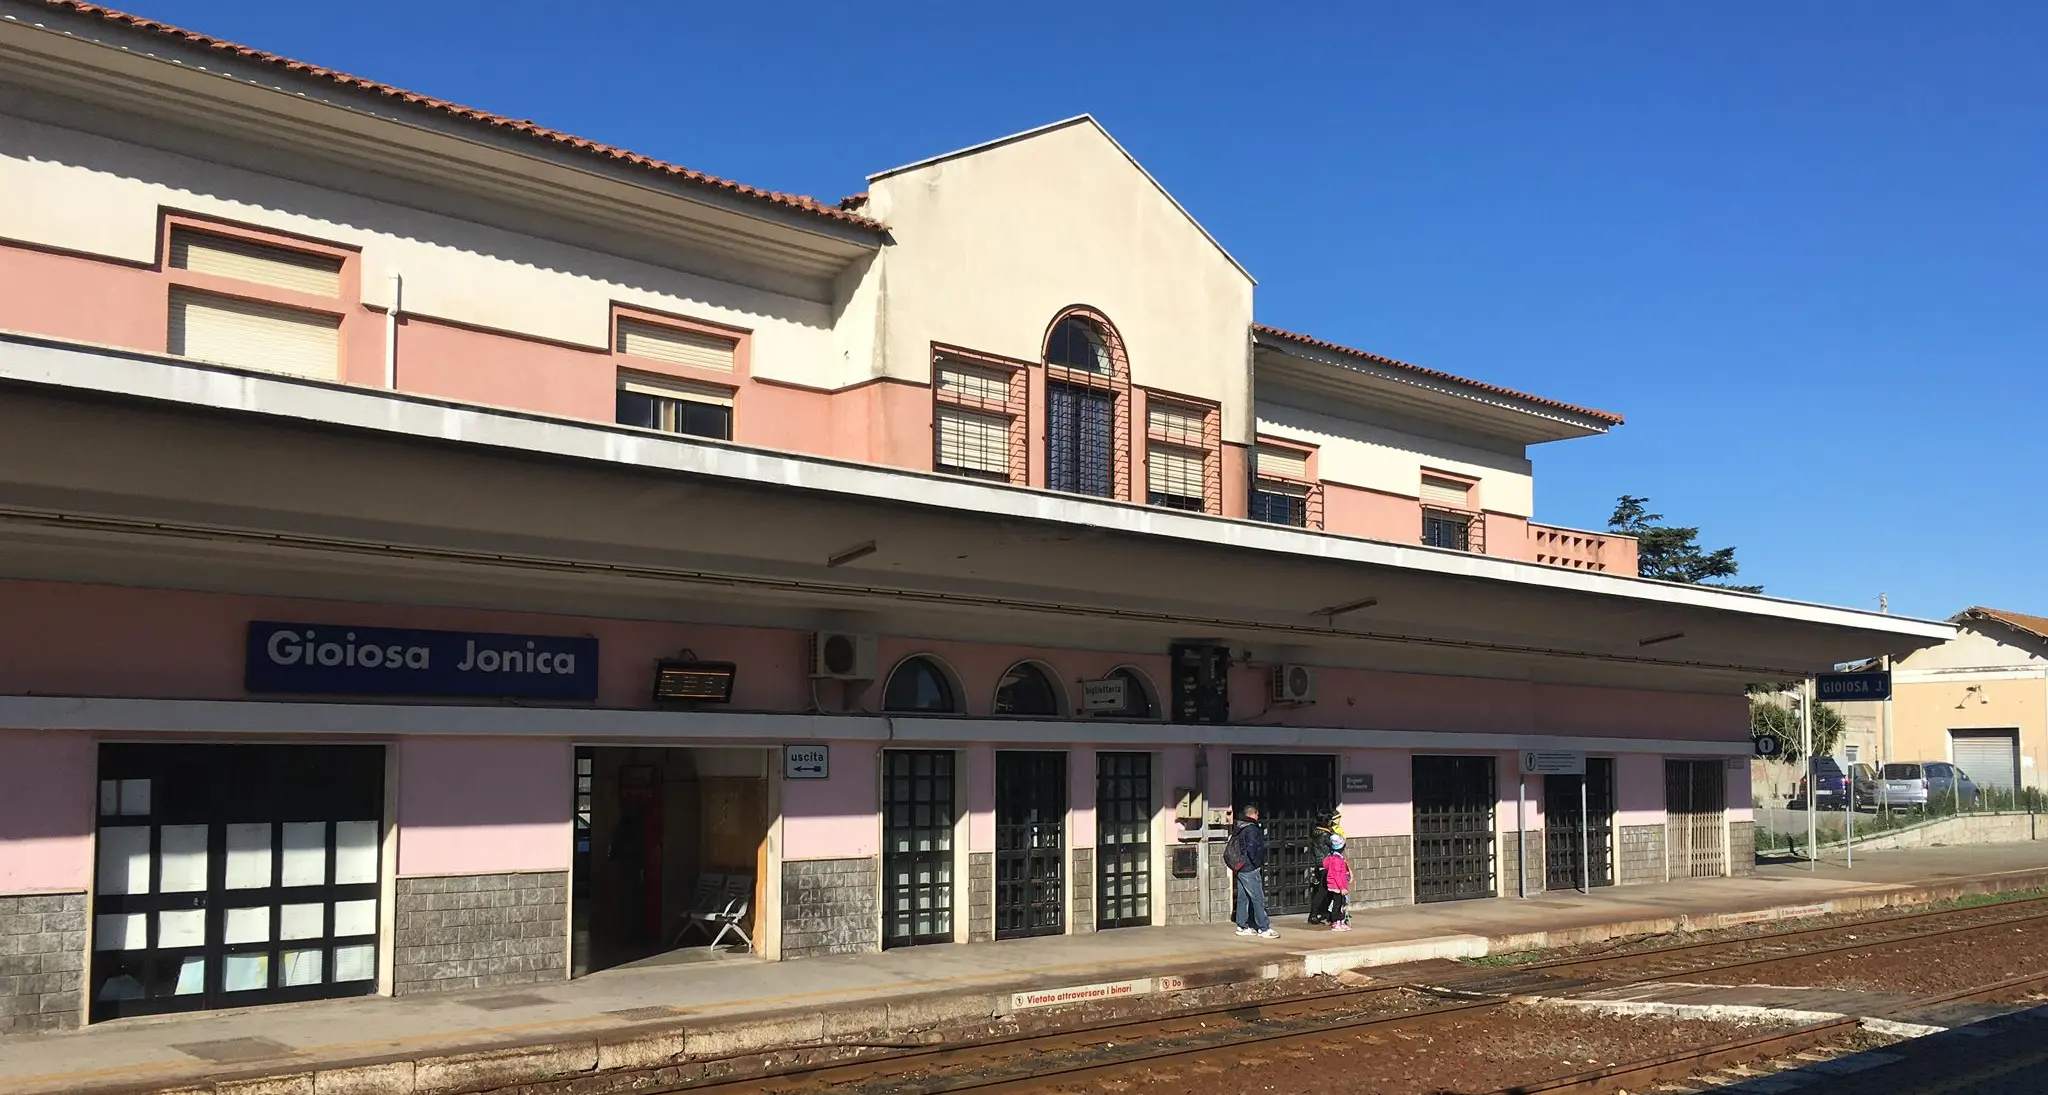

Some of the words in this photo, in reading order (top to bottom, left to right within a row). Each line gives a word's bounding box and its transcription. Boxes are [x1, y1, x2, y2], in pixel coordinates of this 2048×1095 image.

[267, 630, 431, 669] Gioiosa
[456, 640, 576, 675] Jonica
[1823, 680, 1869, 693] GIOIOSA
[791, 751, 824, 762] uscita
[1172, 979, 1182, 988] Do
[1027, 991, 1056, 1004] Vietato
[1057, 989, 1105, 1001] attraversare
[1110, 983, 1132, 994] binari
